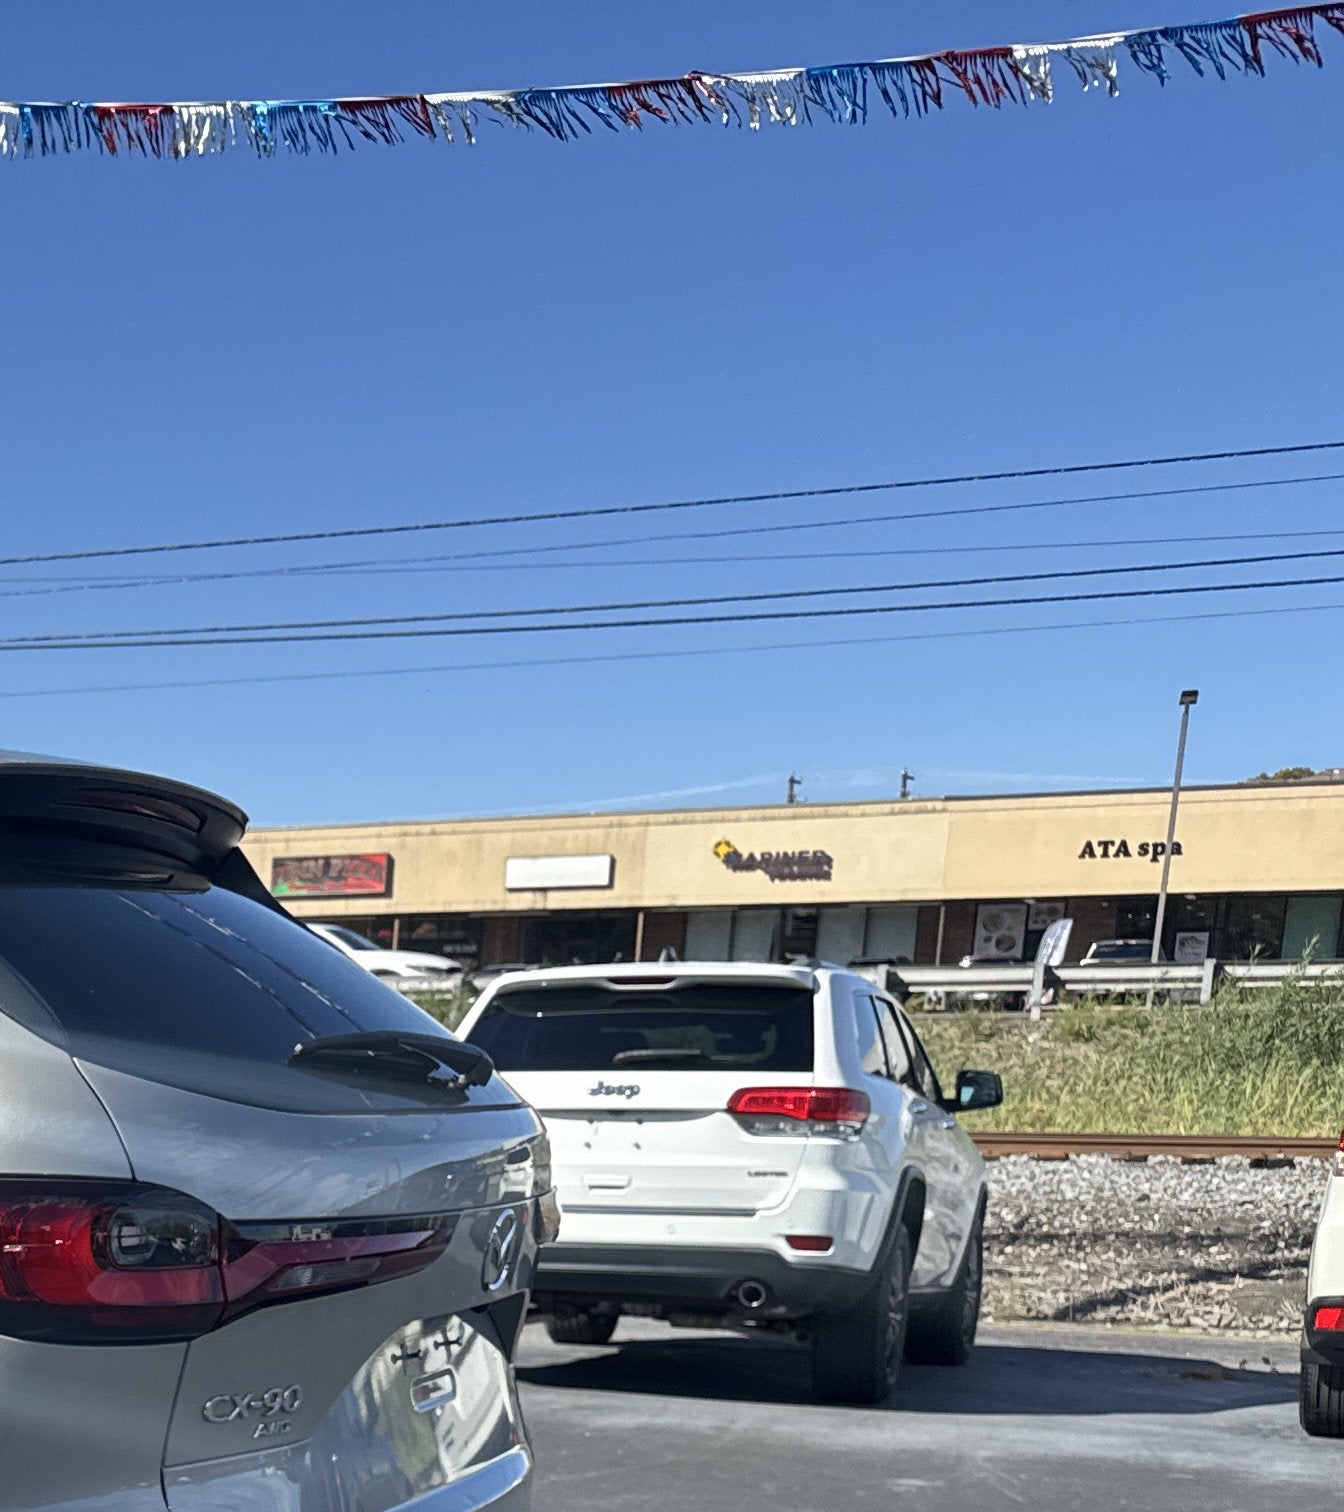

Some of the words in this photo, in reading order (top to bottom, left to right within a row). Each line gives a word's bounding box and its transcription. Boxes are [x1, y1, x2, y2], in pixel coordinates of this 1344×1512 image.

[1078, 839, 1132, 859] ATA
[1137, 841, 1183, 863] spa
[589, 1081, 641, 1100] Jeep
[202, 1384, 304, 1423] CX-90
